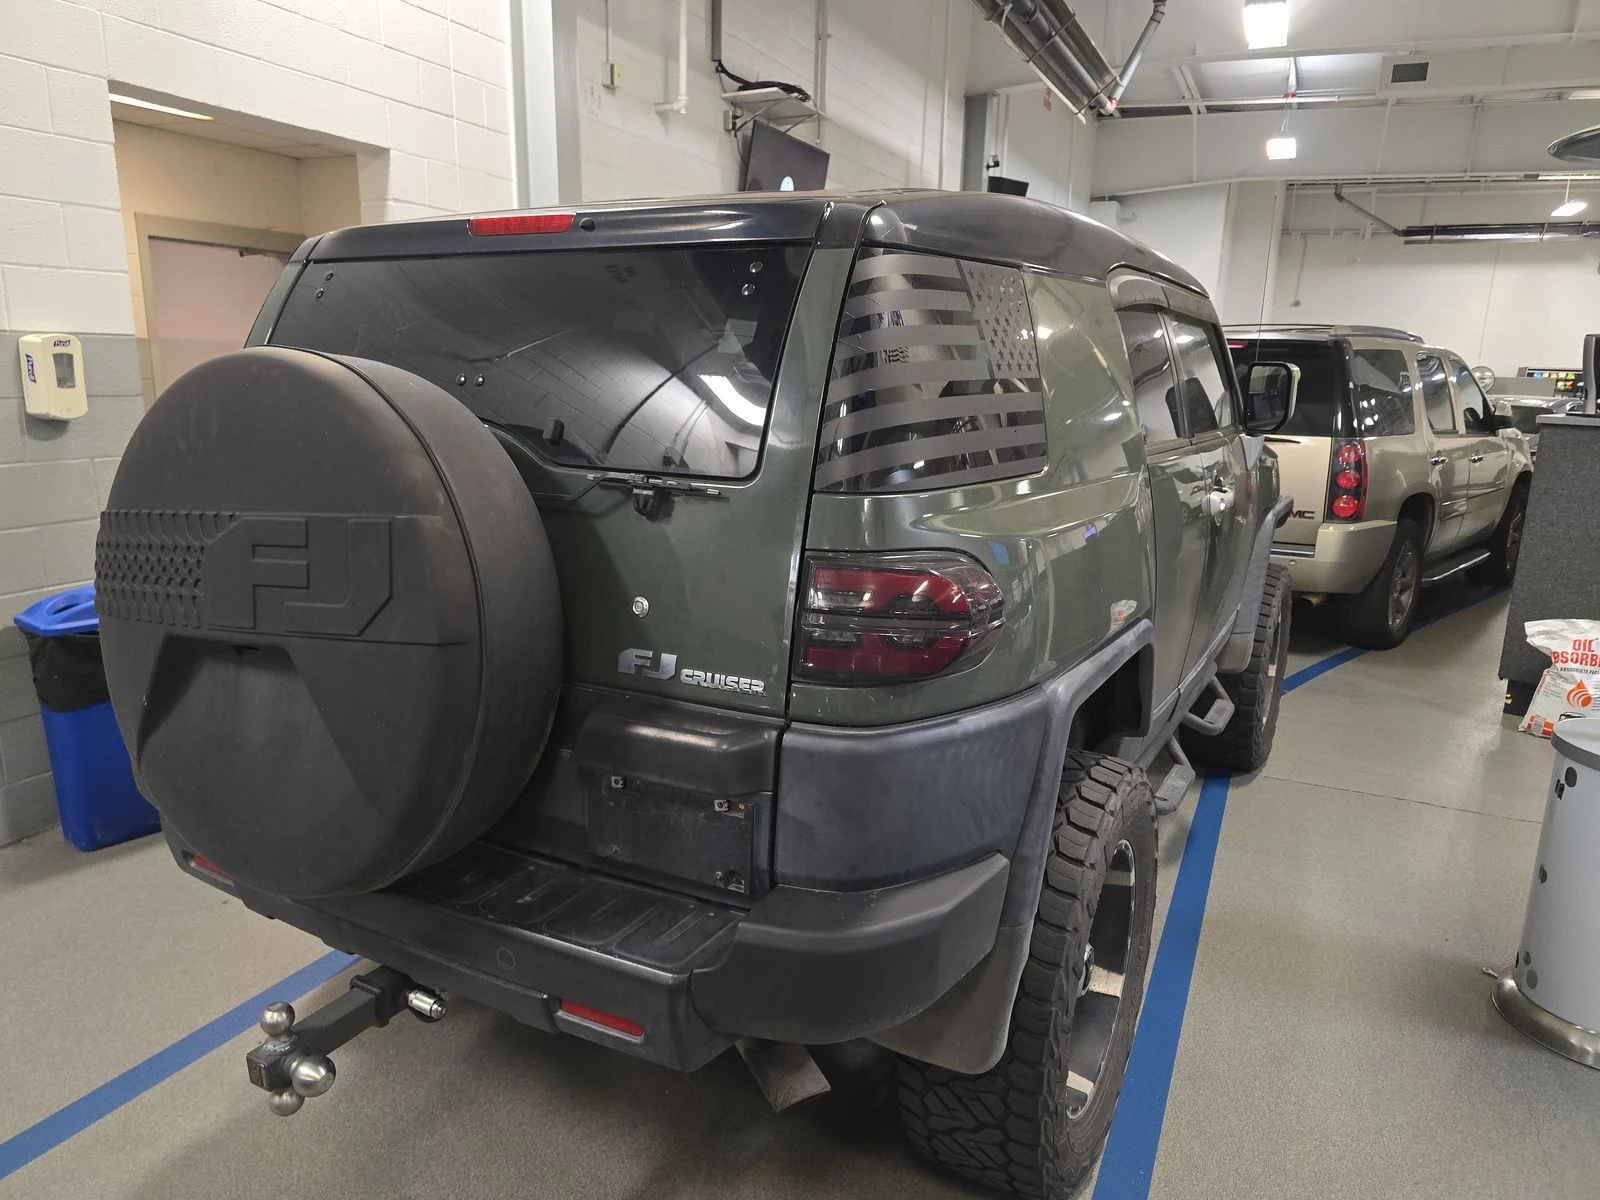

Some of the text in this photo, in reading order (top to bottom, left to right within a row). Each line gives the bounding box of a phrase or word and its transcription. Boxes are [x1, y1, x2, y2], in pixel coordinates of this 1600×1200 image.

[1290, 510, 1315, 519] MC
[202, 516, 393, 637] FJ
[1573, 639, 1594, 652] OIL
[1552, 651, 1600, 667] BSORB
[617, 647, 768, 697] FJ CRUISER
